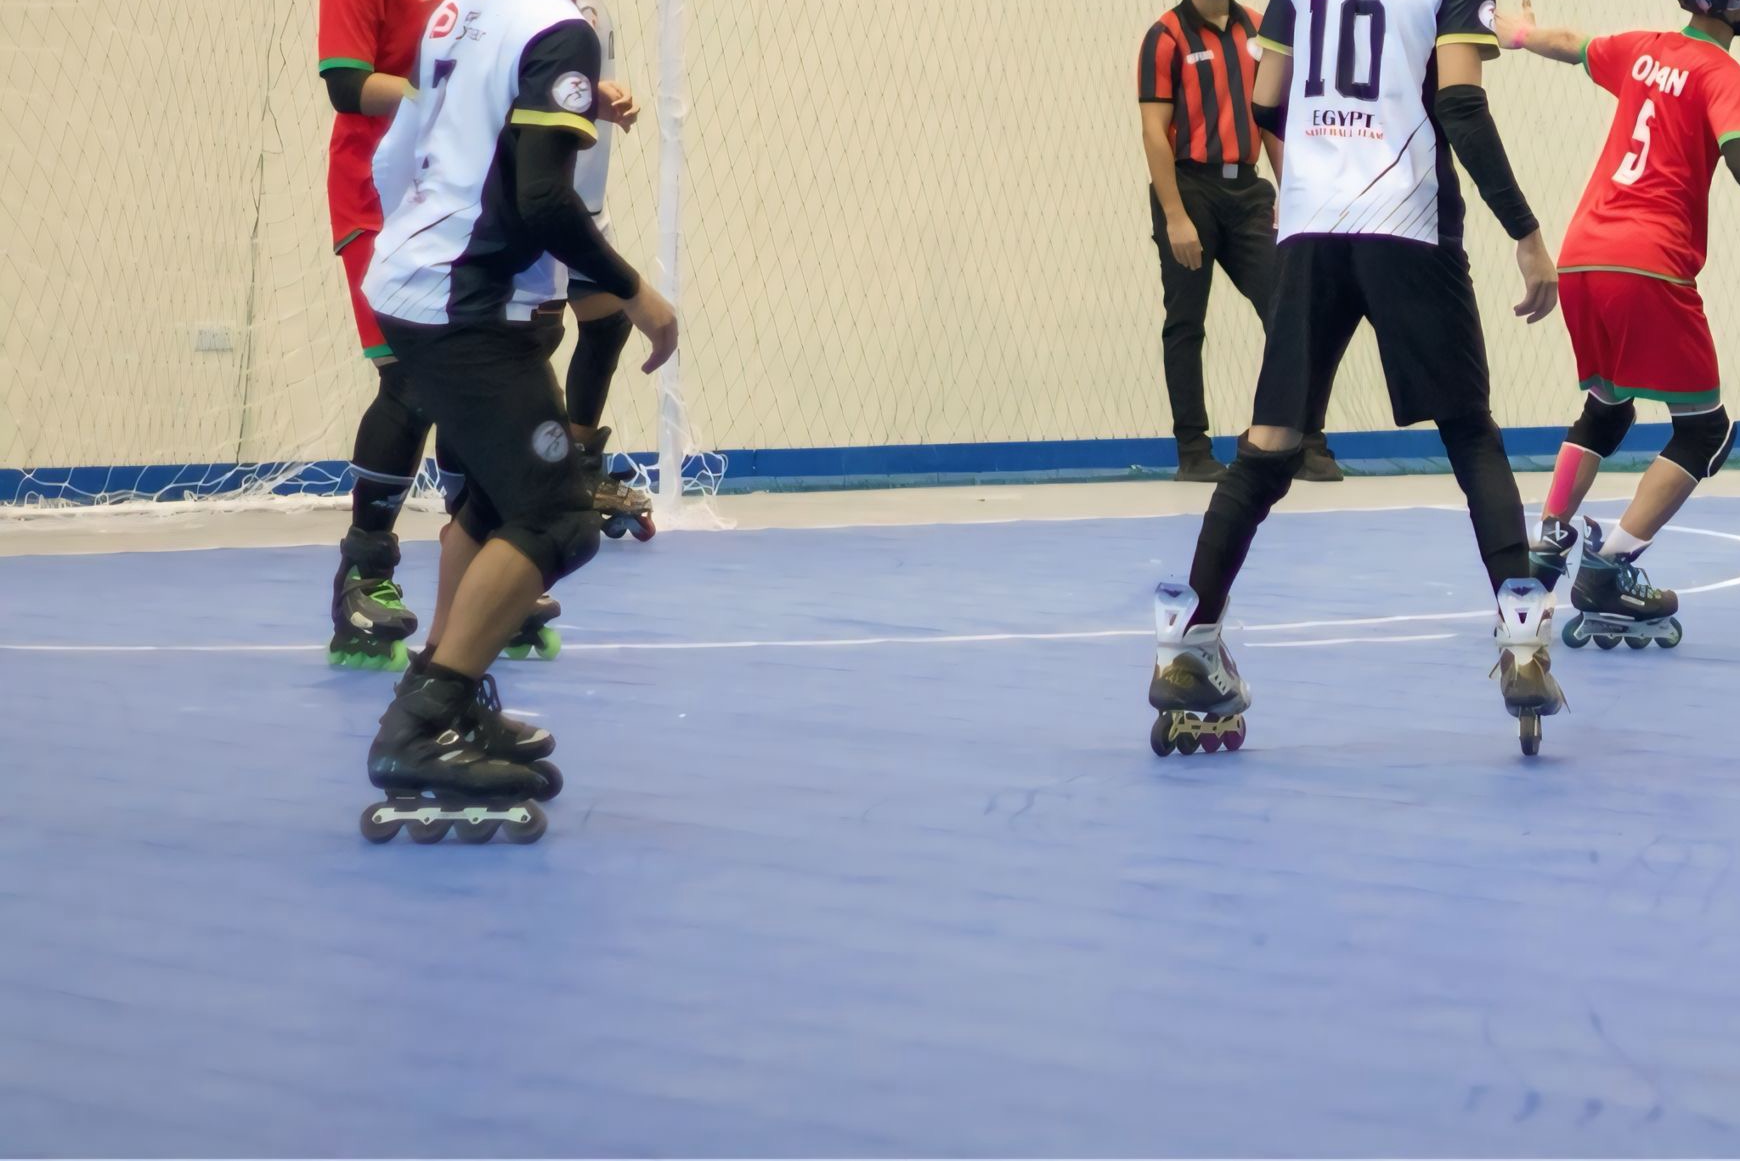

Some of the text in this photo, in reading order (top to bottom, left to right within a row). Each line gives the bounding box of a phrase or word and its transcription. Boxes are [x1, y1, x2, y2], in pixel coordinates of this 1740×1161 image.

[1632, 54, 1689, 97] OMAN
[1313, 109, 1376, 128] EGYPT
[1611, 98, 1656, 185] 5
